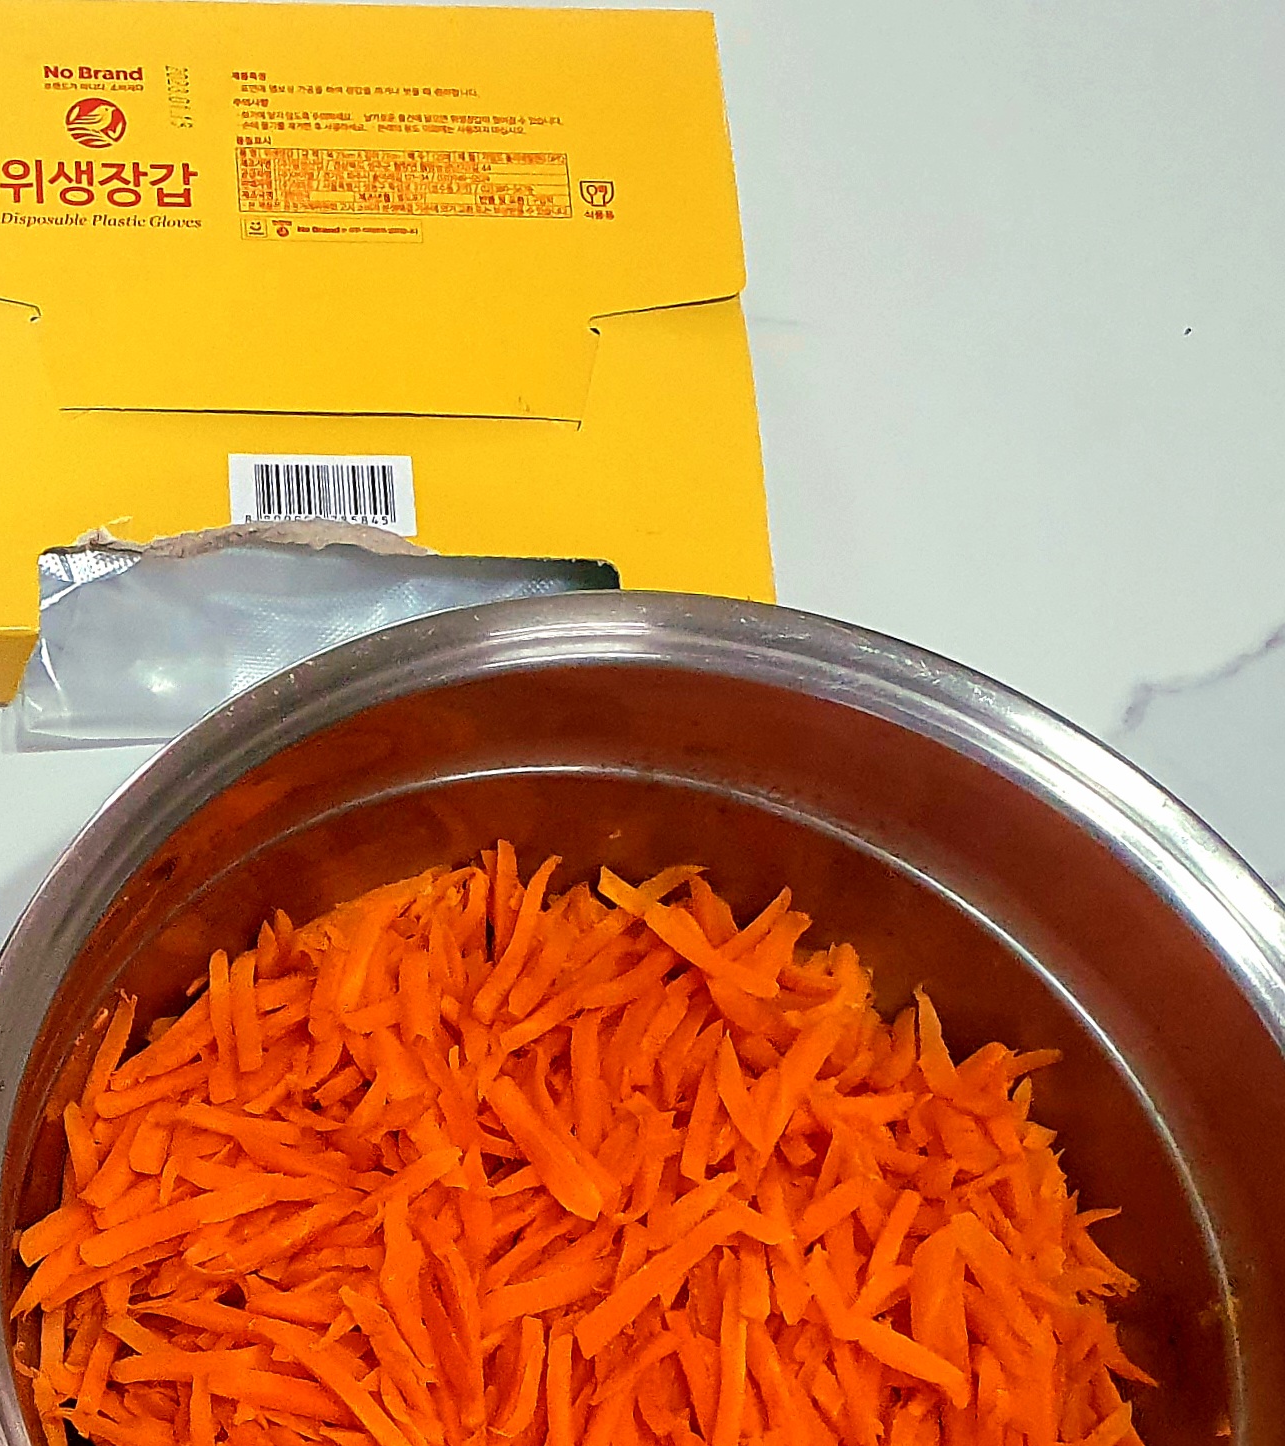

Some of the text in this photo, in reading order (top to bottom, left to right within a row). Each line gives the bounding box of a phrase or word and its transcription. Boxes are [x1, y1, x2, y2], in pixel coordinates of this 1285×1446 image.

[43, 65, 144, 81] No Brand
[0, 159, 198, 208] 위생장갑
[0, 212, 202, 229] Disposable Plastic Gloves
